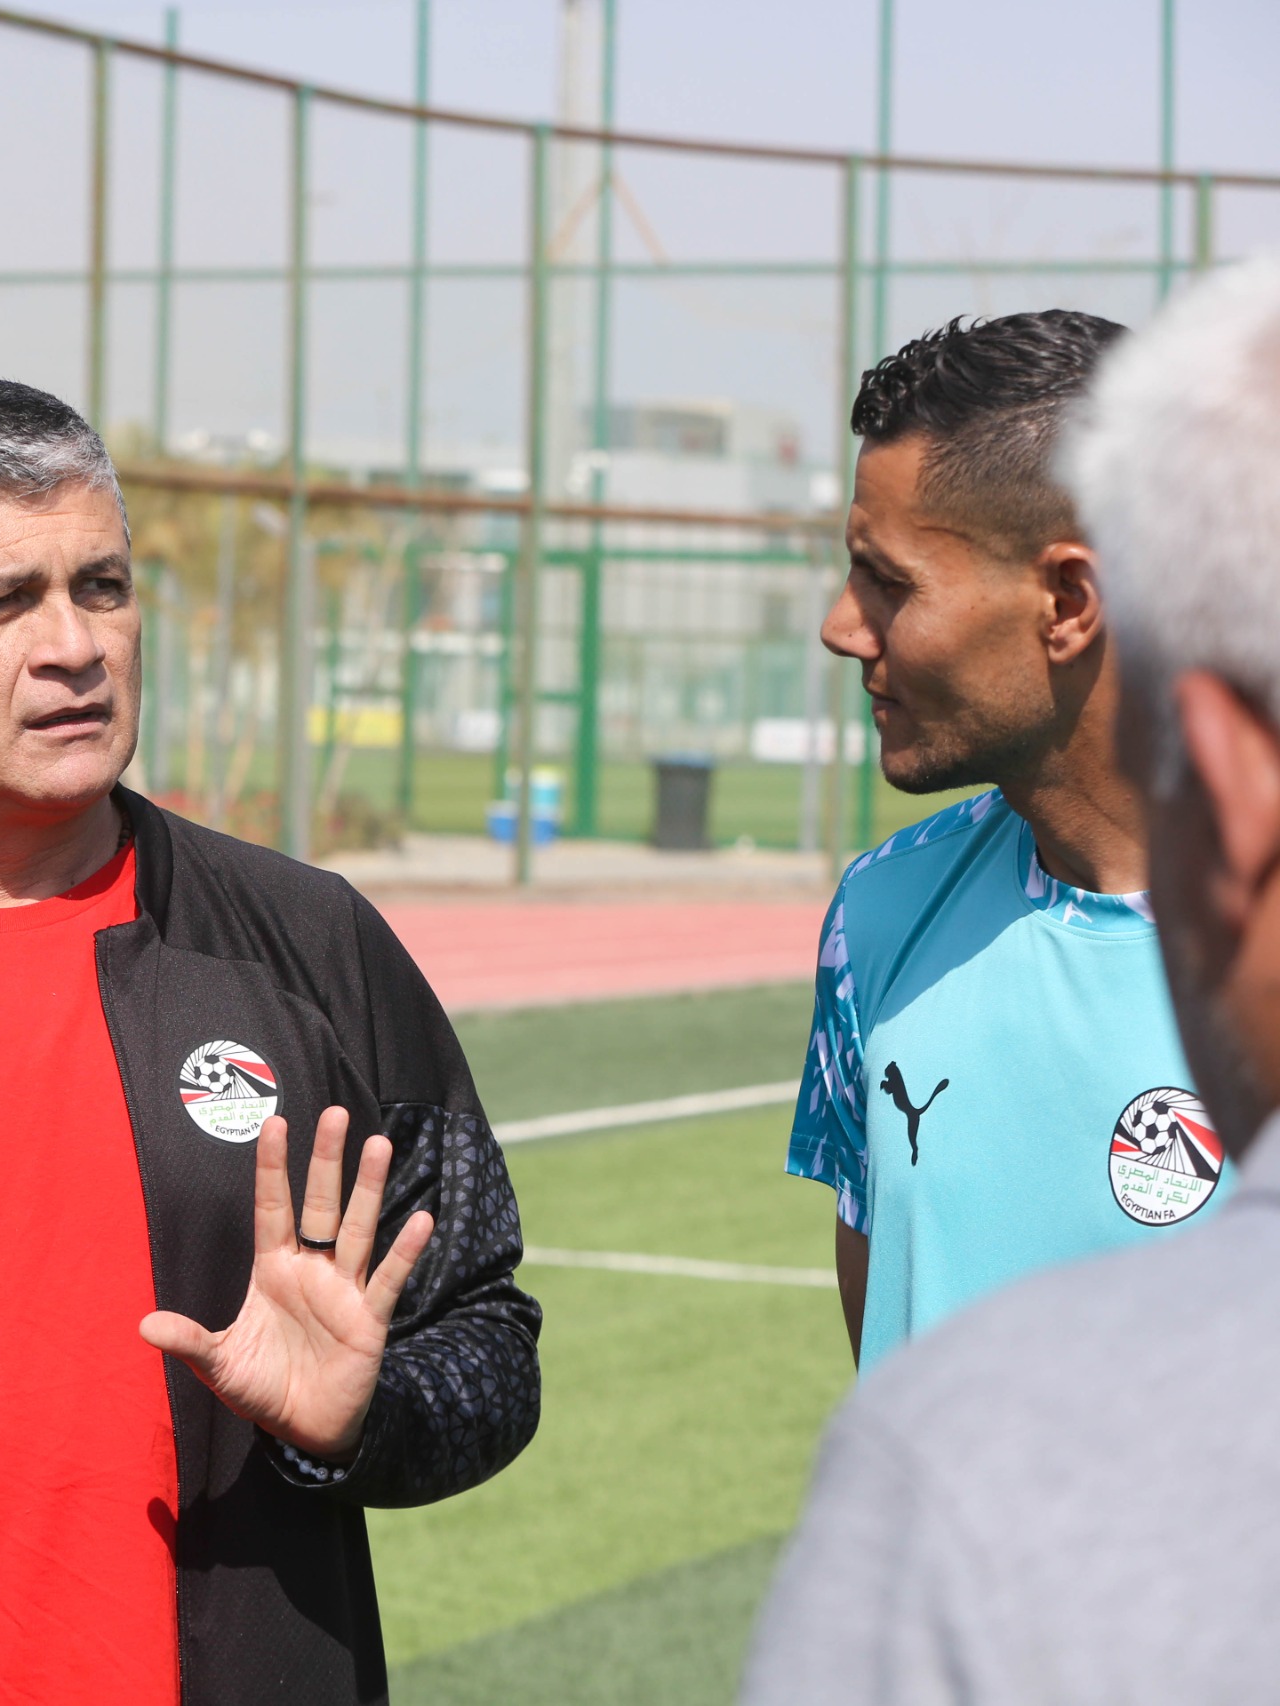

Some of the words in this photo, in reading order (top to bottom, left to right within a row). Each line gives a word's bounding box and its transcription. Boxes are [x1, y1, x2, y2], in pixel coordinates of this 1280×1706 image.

[215, 1125, 251, 1136] EGYPTIAN
[251, 1122, 260, 1131] FA
[1121, 1193, 1161, 1220] EGYPTIAN
[1164, 1209, 1176, 1220] FA
